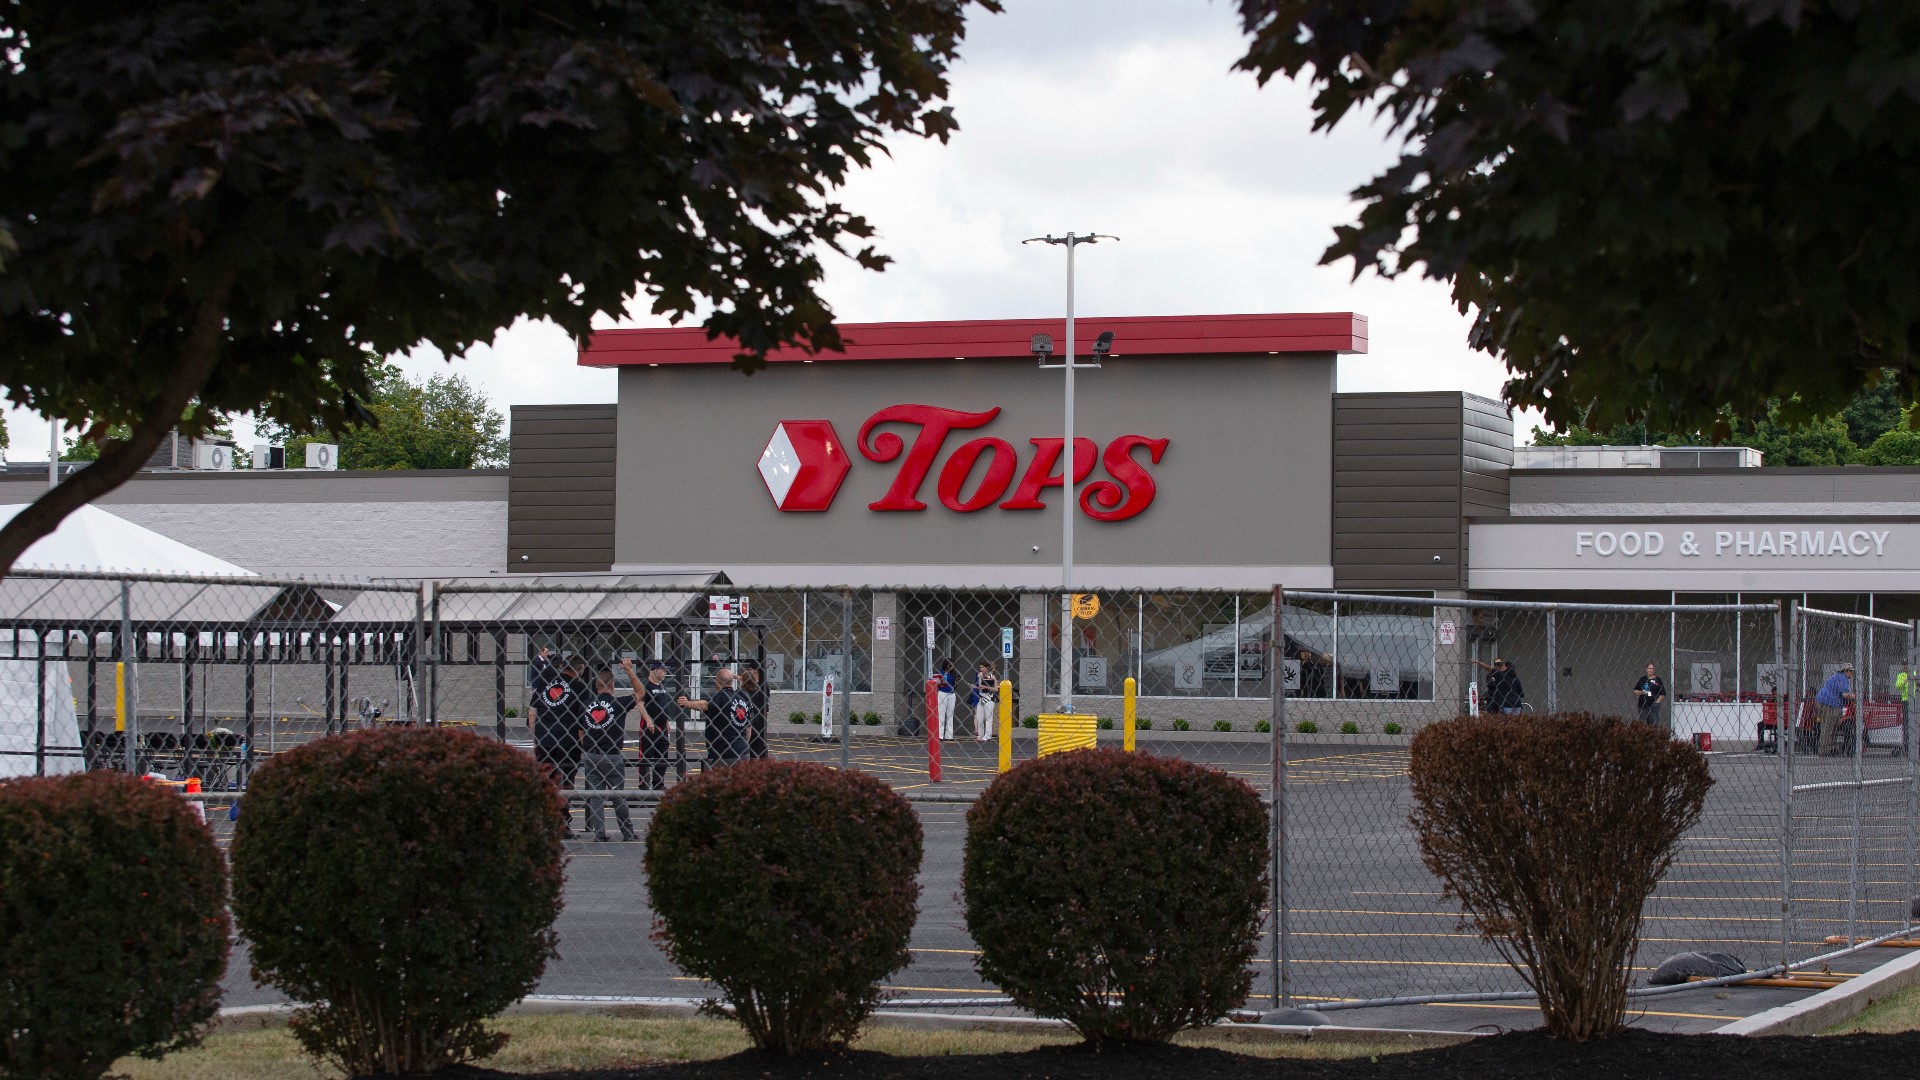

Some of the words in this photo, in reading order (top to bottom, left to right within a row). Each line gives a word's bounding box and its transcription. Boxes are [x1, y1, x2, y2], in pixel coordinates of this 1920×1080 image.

[1576, 531, 1665, 556] FOOD
[1680, 531, 1701, 556] &
[1715, 530, 1890, 556] PHARMACY
[545, 680, 559, 691] ALL
[560, 680, 571, 693] ONE
[586, 701, 599, 714] ALL
[600, 700, 614, 714] ONE
